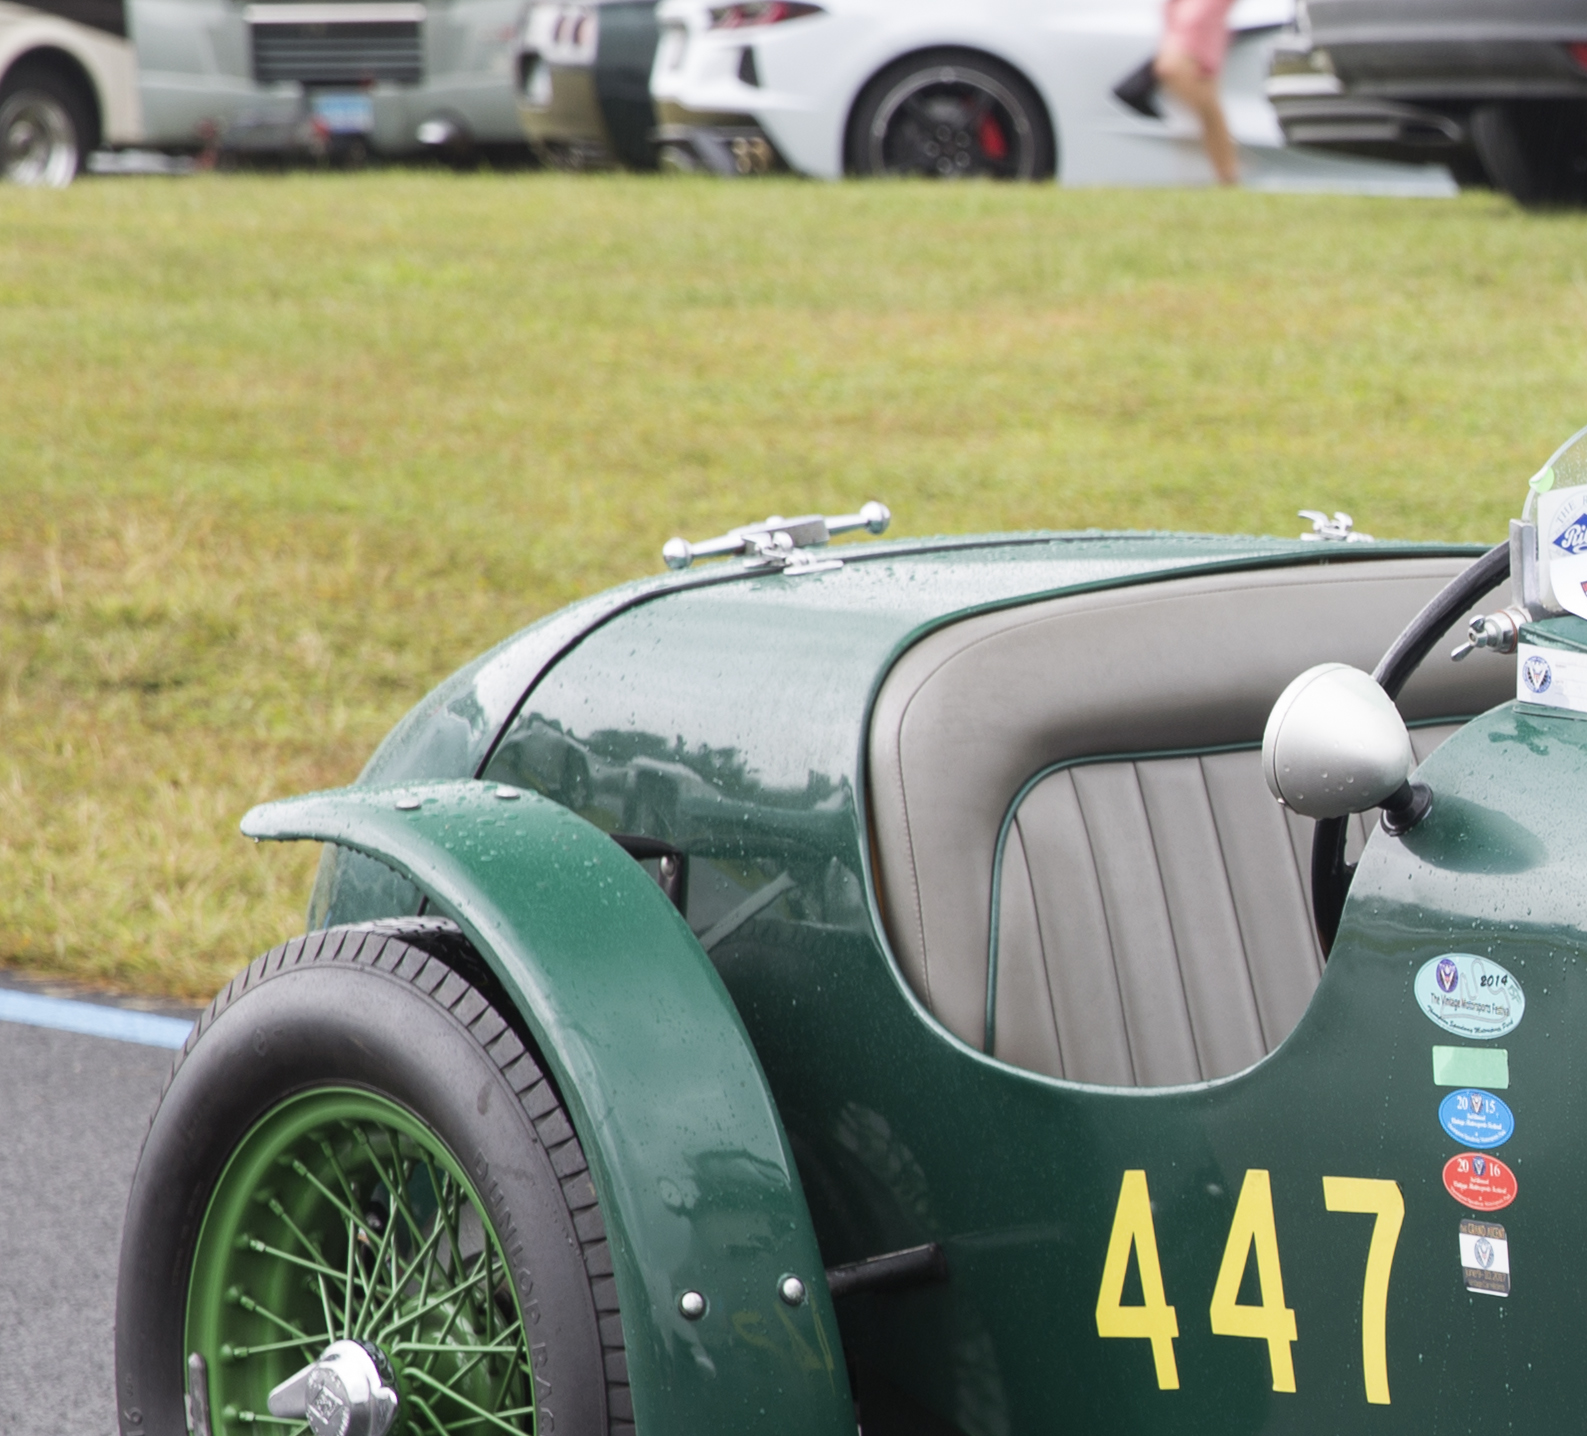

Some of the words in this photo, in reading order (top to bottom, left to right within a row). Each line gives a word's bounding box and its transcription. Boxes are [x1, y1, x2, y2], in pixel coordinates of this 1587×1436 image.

[1556, 500, 1578, 524] THE
[1480, 975, 1508, 987] 2014
[1431, 992, 1440, 1005] The
[1441, 995, 1461, 1011] Vintage
[1461, 999, 1492, 1014] Motorsports
[1492, 1003, 1510, 1017] Festival
[1457, 1095, 1468, 1110] 20
[1485, 1099, 1496, 1114] 15
[1457, 1158, 1469, 1173] 20
[1489, 1162, 1501, 1177] 16
[1095, 1168, 1405, 1405] 447
